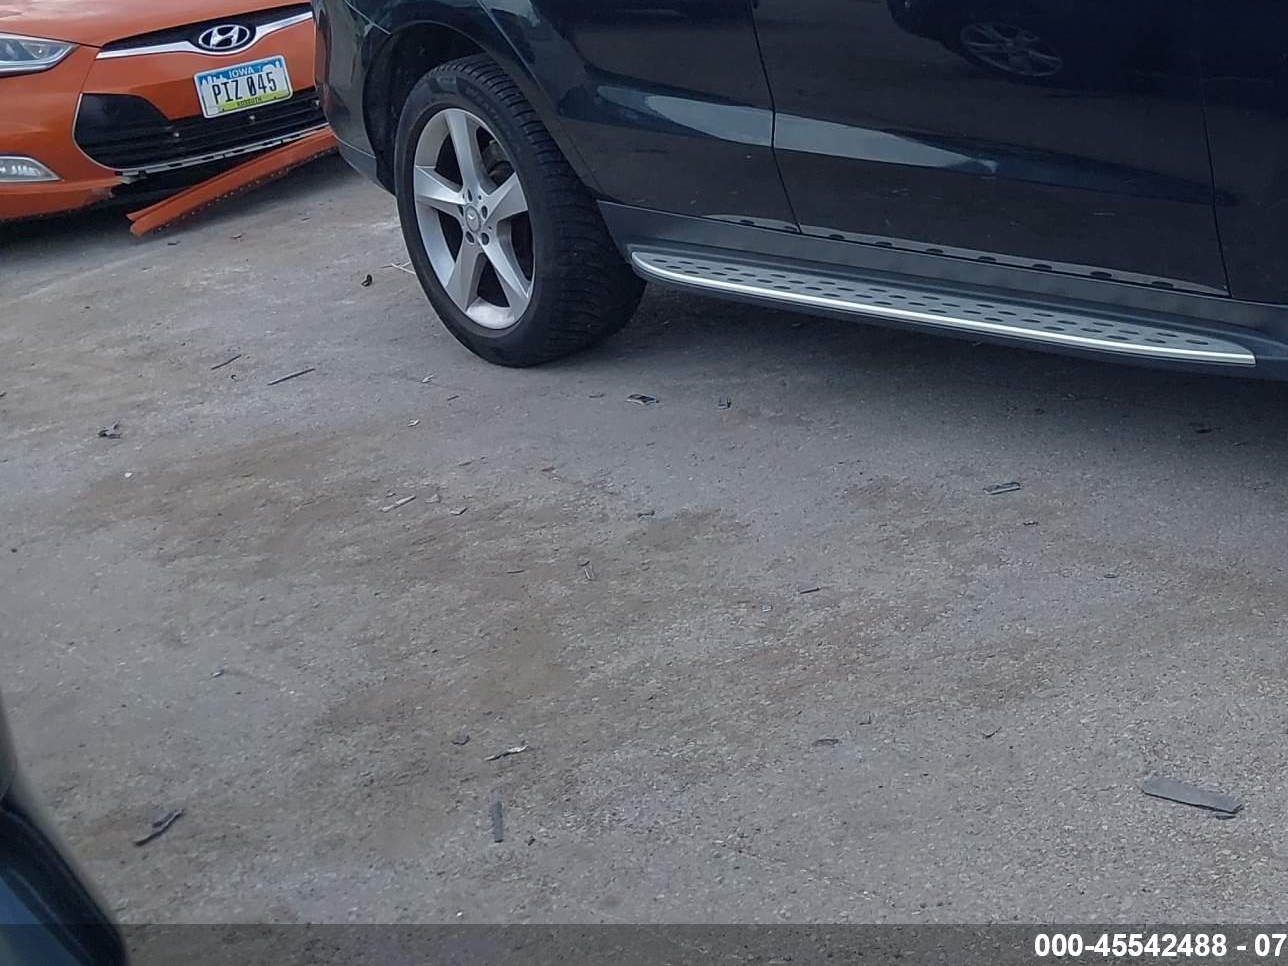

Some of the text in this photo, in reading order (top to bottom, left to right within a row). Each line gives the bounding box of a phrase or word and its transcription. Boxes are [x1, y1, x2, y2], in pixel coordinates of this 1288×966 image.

[229, 66, 255, 78] IOWA
[212, 79, 243, 104] PIZ
[246, 71, 277, 96] 045
